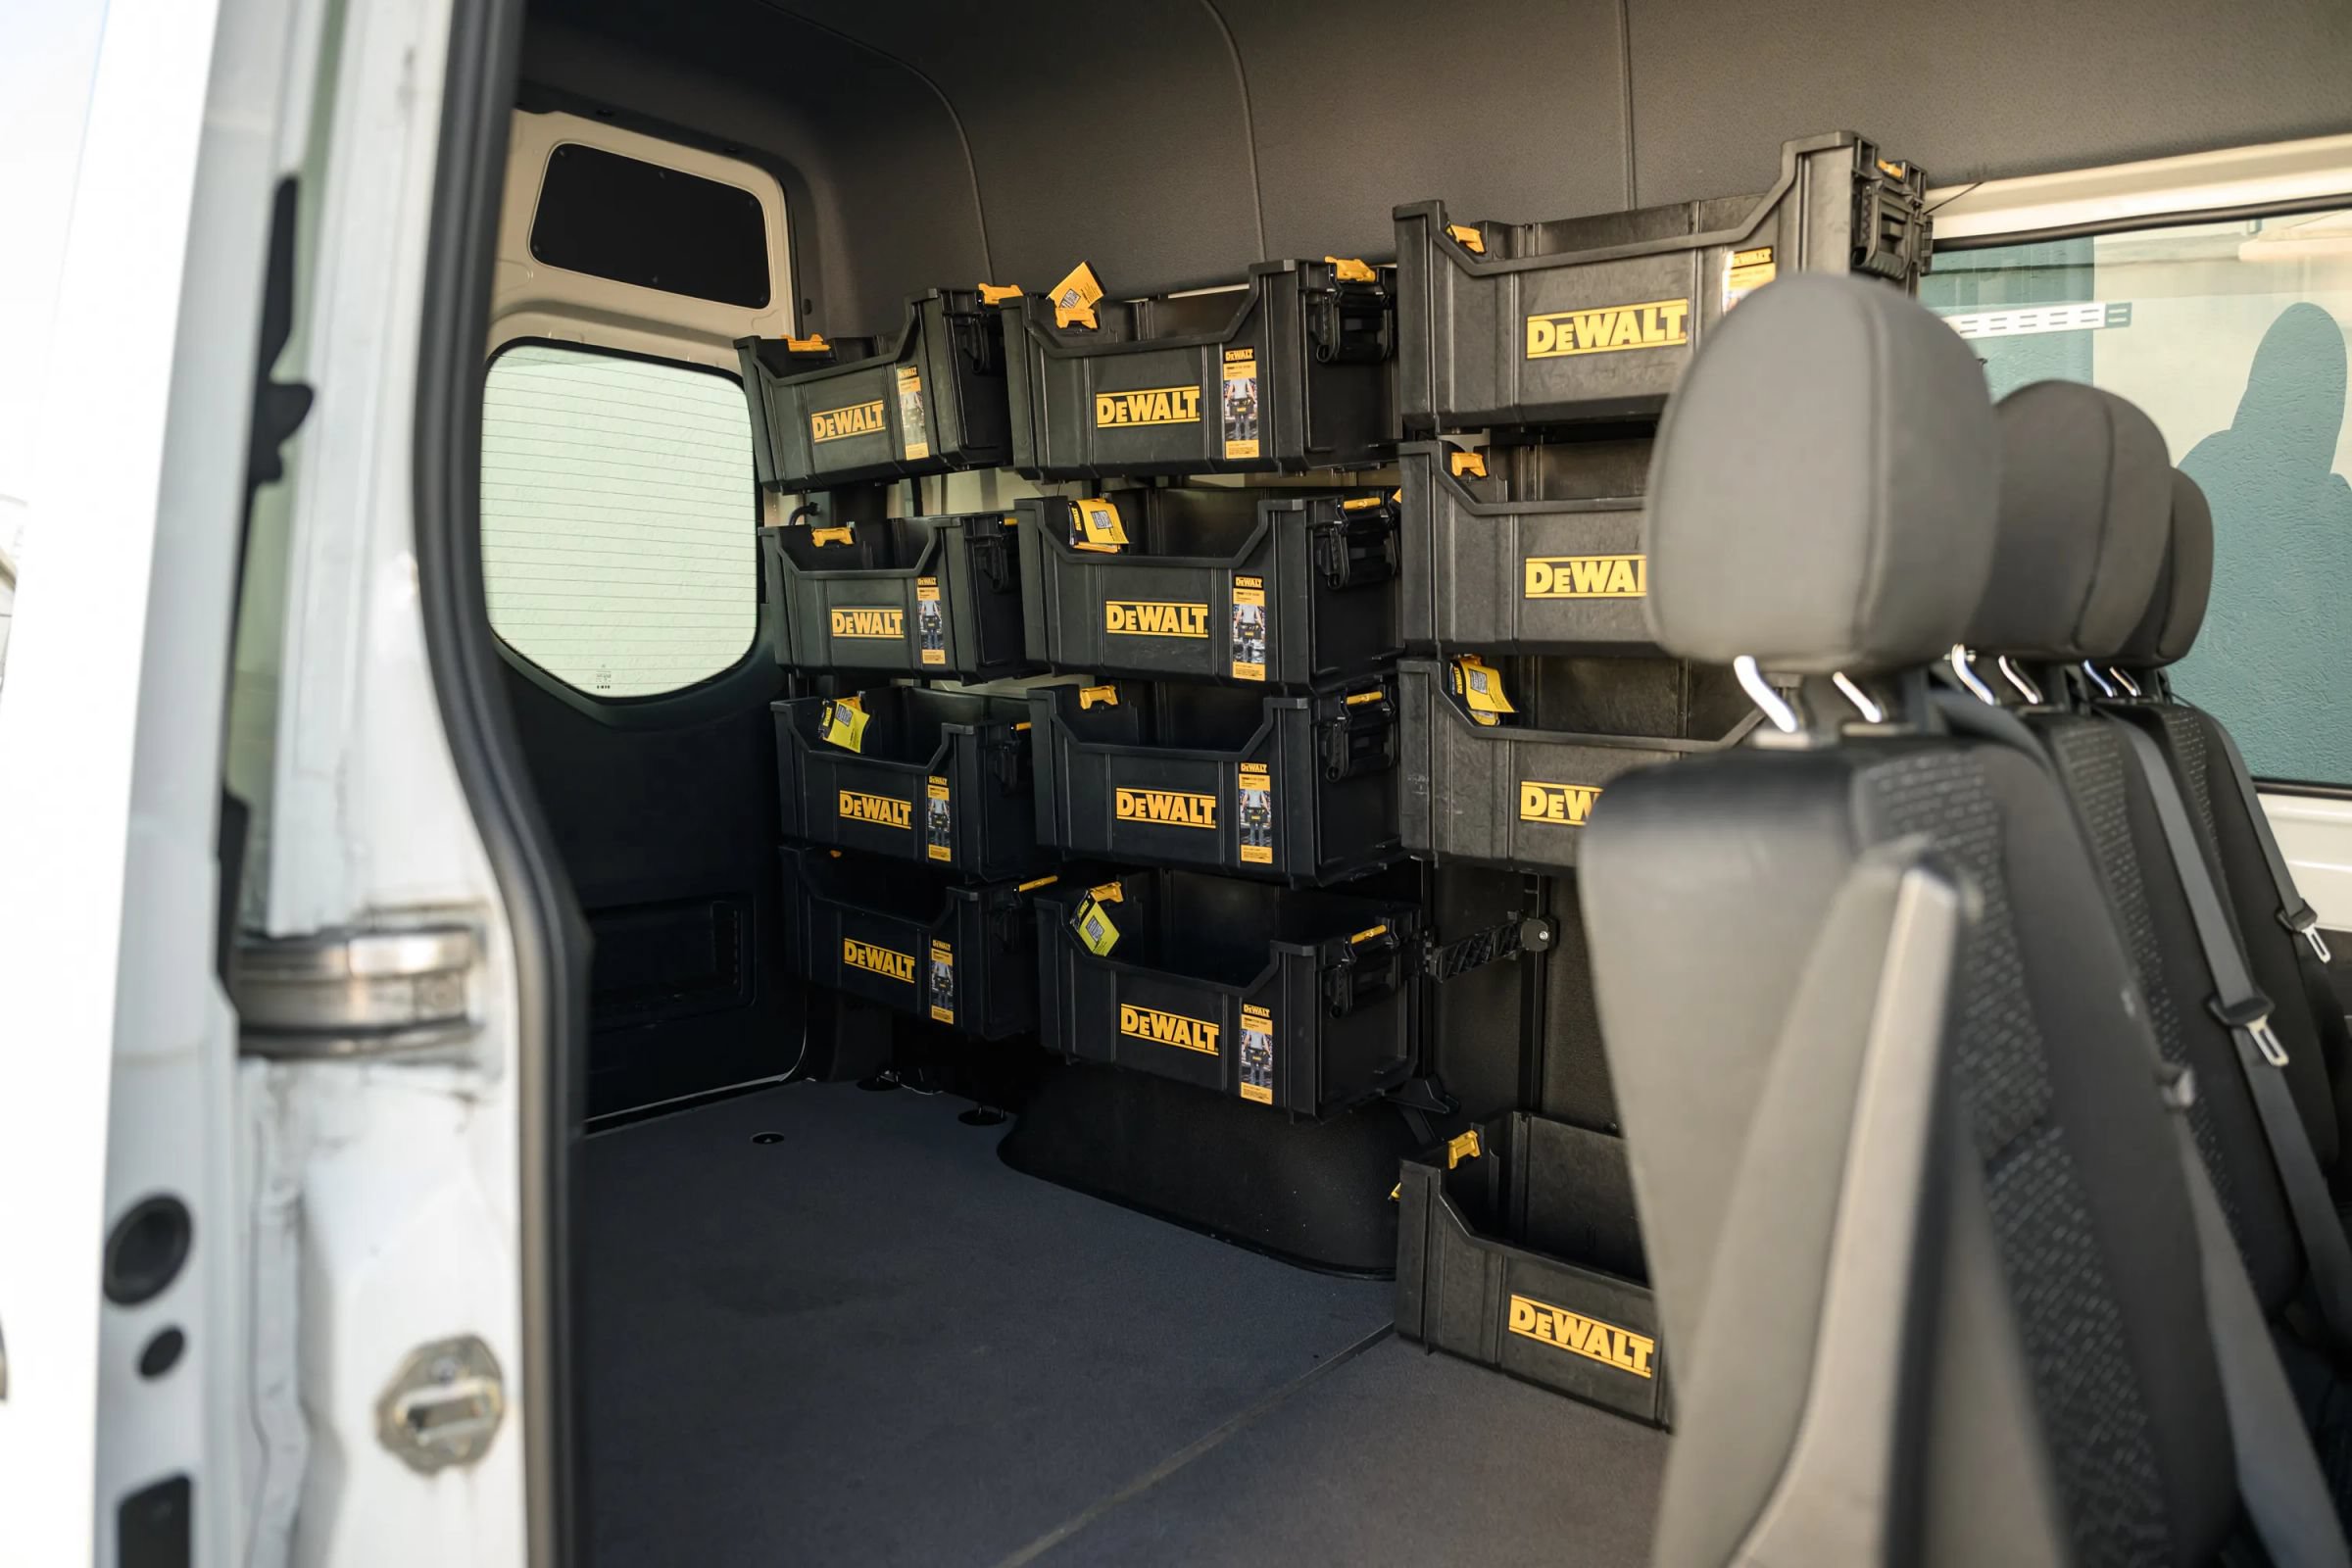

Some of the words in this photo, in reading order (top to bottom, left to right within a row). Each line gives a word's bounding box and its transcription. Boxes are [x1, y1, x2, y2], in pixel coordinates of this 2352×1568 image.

[1526, 305, 1688, 356] DEWALT
[812, 404, 885, 440] DEWALT
[1097, 391, 1200, 424] DEWALT
[1526, 560, 1646, 593] DEWA
[832, 610, 904, 636] DEWALT
[1106, 606, 1208, 634] DEWALT
[840, 794, 911, 825] DEWALT
[1117, 792, 1215, 824] DEWALT
[1521, 786, 1599, 820] DEW
[844, 941, 914, 980] DEWALT
[1121, 1006, 1219, 1053] DEWALT
[1509, 1298, 1653, 1374] DEWALT
